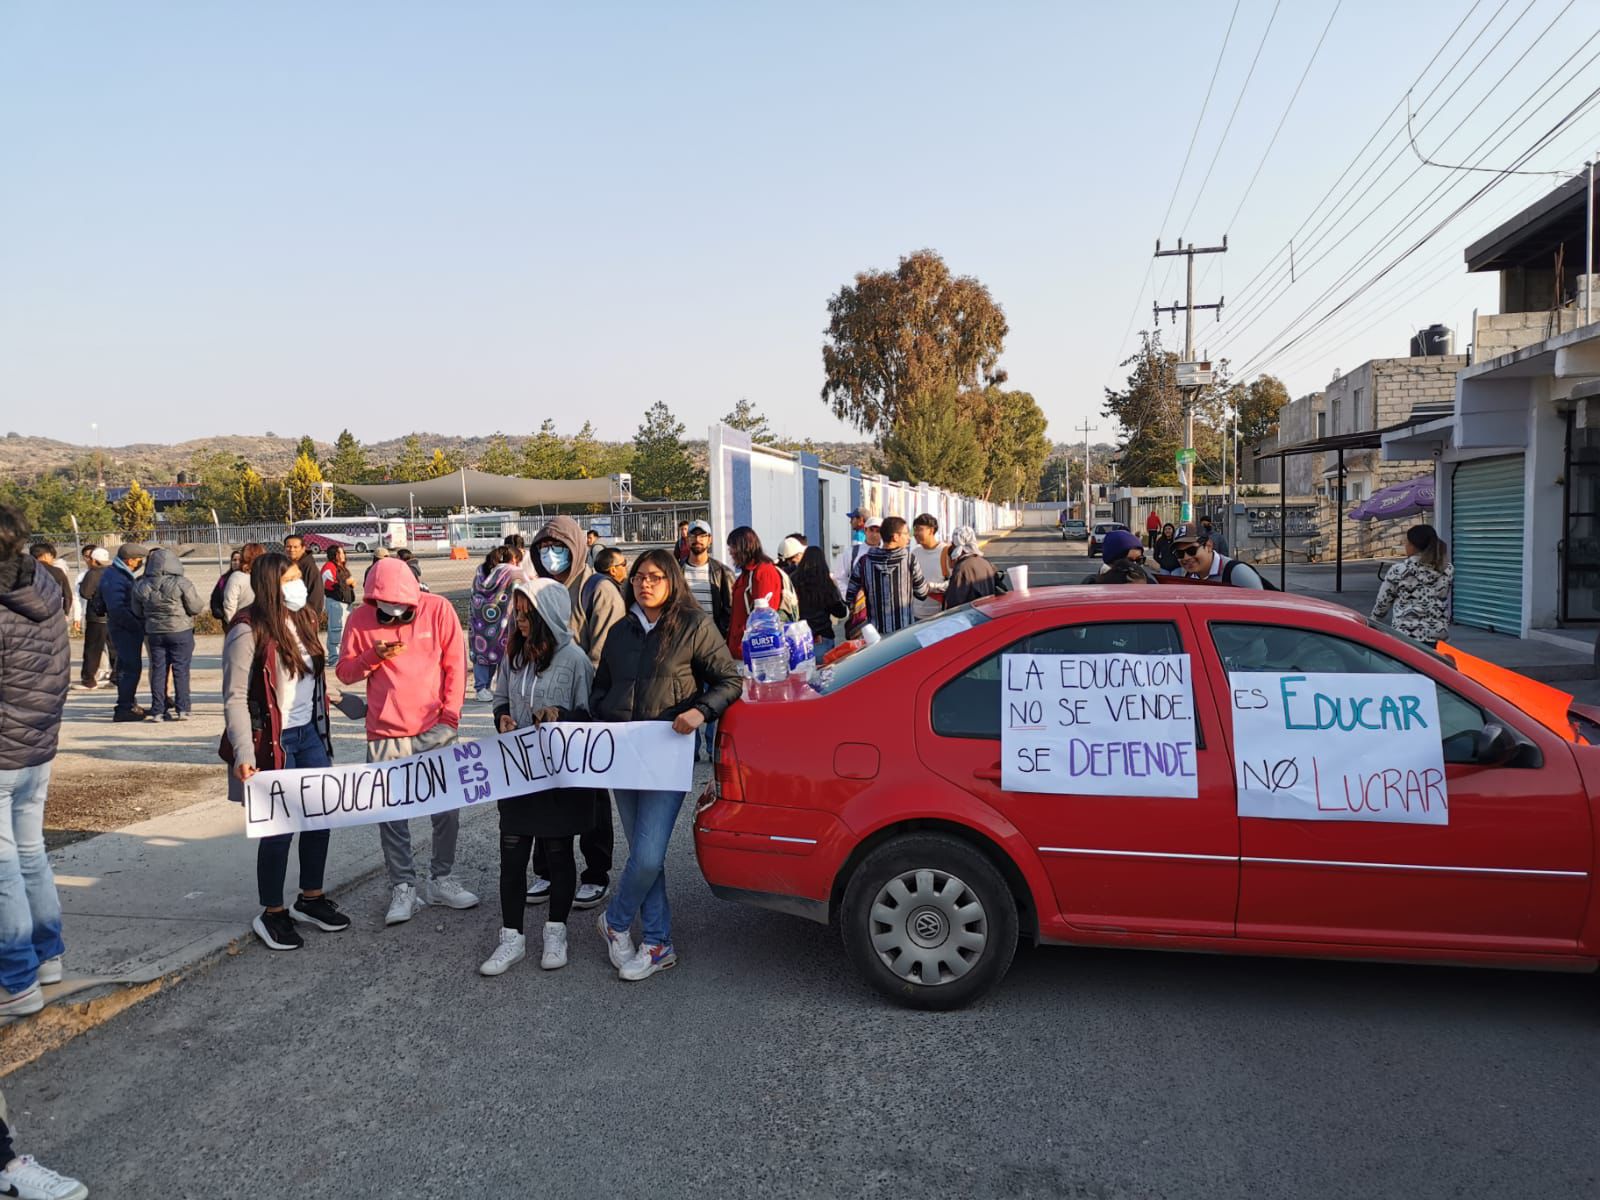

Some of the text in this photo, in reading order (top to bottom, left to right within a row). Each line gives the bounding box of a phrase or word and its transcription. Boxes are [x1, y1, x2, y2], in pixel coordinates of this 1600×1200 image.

[1007, 656, 1184, 692] LA EDUCACIÓN
[1009, 694, 1192, 728] NO SE VENDE.
[1234, 675, 1429, 731] ES EDUCAR
[453, 741, 482, 762] NO
[497, 726, 615, 787] NEGOCIO
[1017, 737, 1197, 777] SE DEFIENDE
[247, 755, 448, 824] LA EDUCACIÓN
[458, 761, 489, 785] ES
[1312, 756, 1449, 813] LUCRAR
[463, 781, 492, 804] UN
